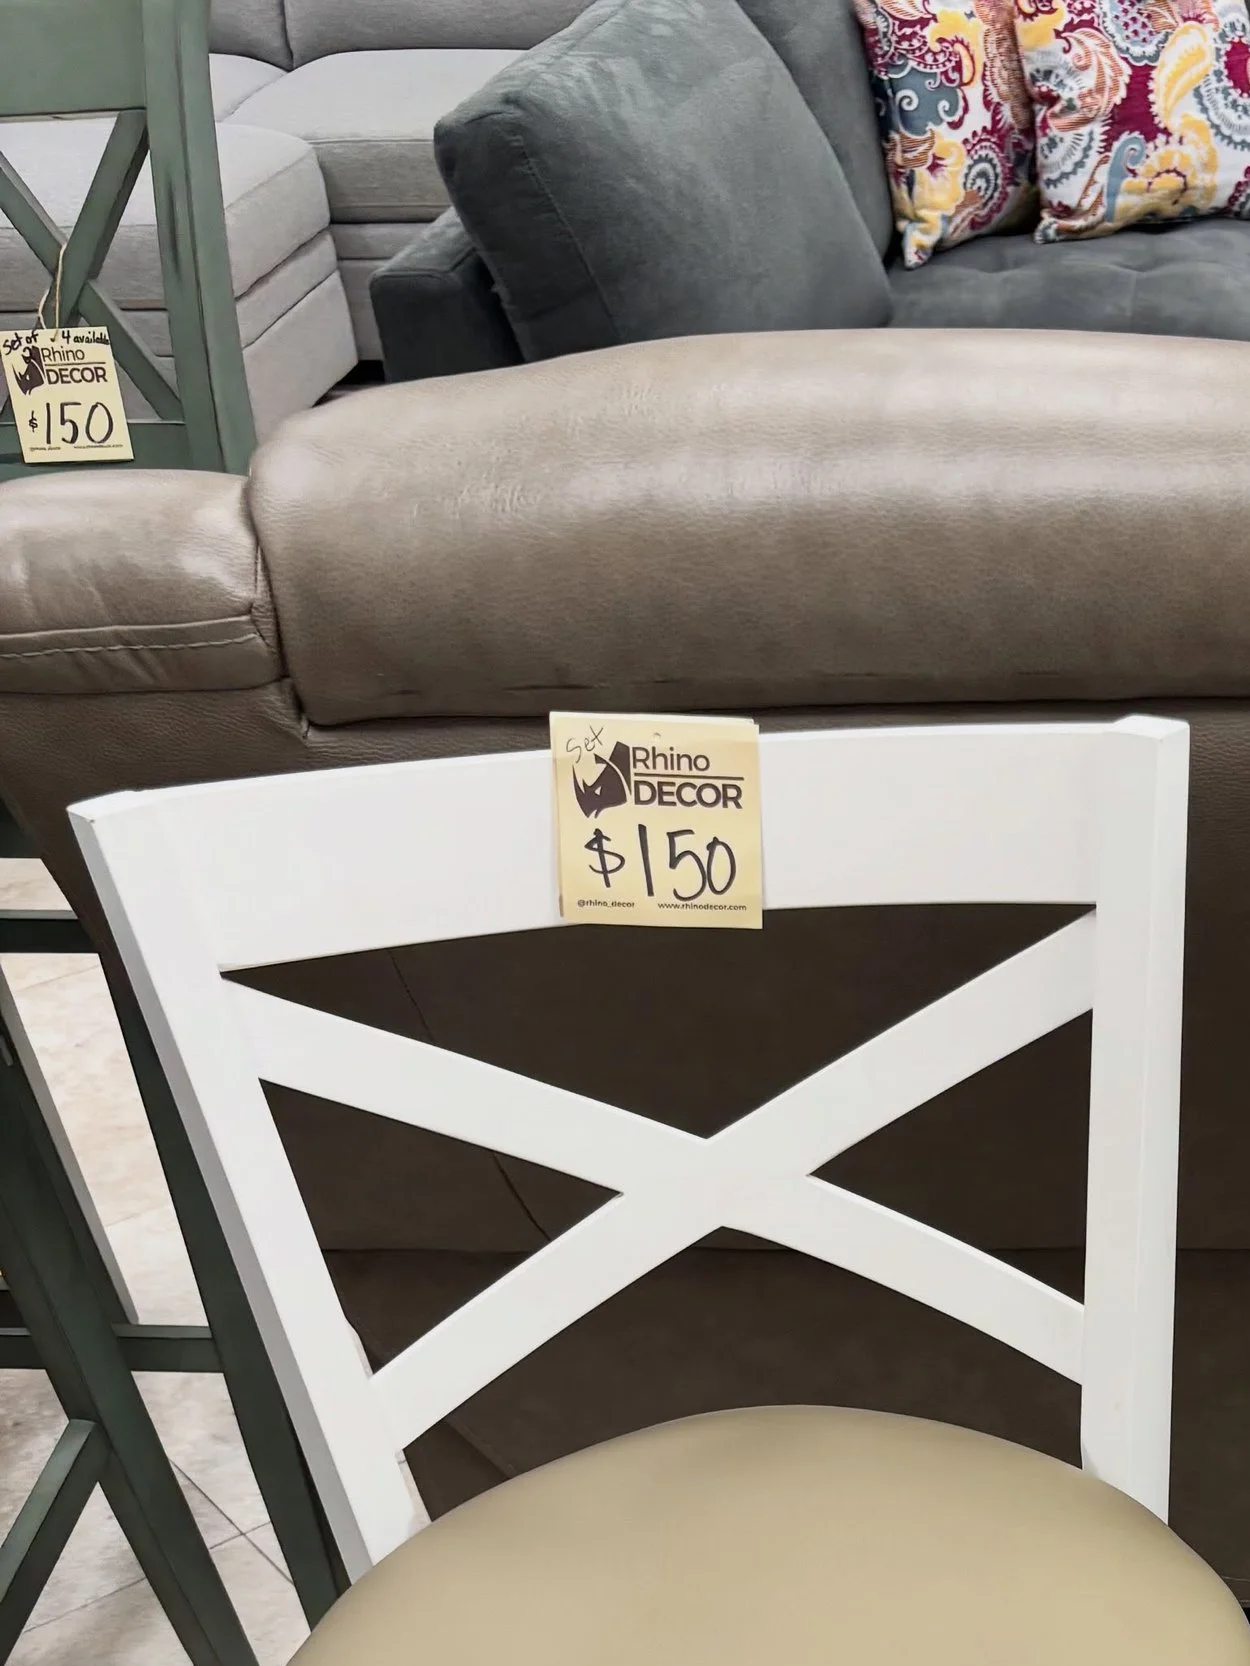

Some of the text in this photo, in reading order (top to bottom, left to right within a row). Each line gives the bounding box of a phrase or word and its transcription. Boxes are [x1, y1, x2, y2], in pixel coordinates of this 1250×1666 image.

[41, 345, 85, 362] Rhino
[45, 366, 108, 385] DECOR
[28, 401, 114, 444] $150
[632, 745, 711, 772] Rhino
[633, 780, 744, 810] DECOR
[584, 823, 737, 902] $150
[657, 902, 748, 911] www.rhinodecor.com
